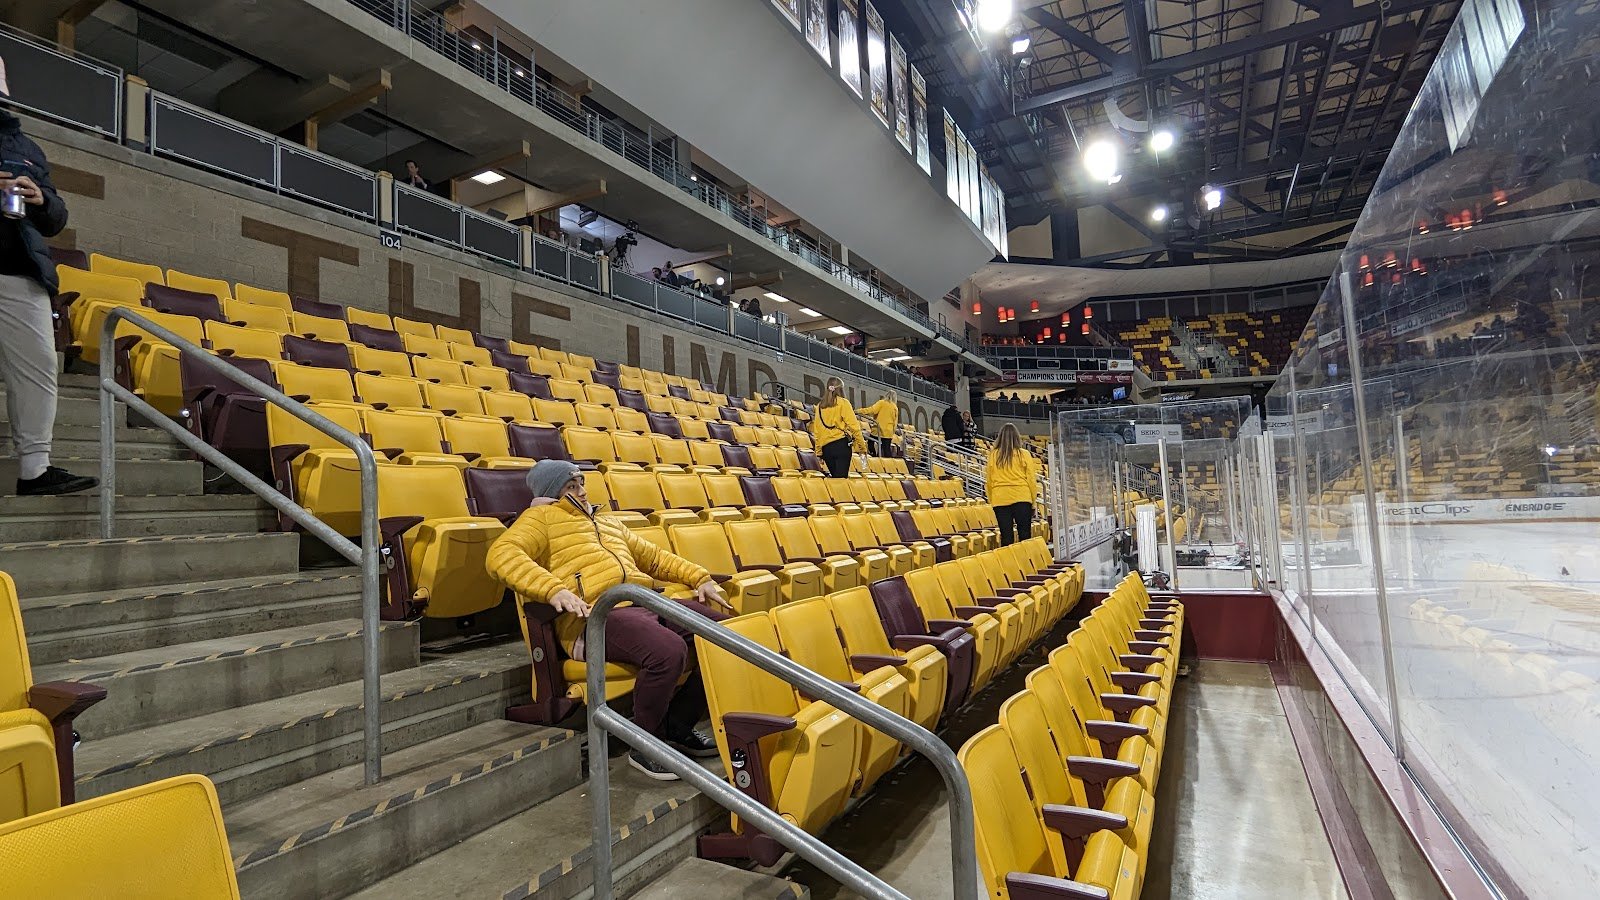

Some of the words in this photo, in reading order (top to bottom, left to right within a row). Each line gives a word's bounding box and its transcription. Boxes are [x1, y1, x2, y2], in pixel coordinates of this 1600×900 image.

[380, 234, 401, 250] 104
[1018, 373, 1055, 381] CHAMPIONS
[1056, 373, 1076, 381] LODGE
[1421, 503, 1471, 517] Clips
[1505, 502, 1567, 512] ENBRIDGE
